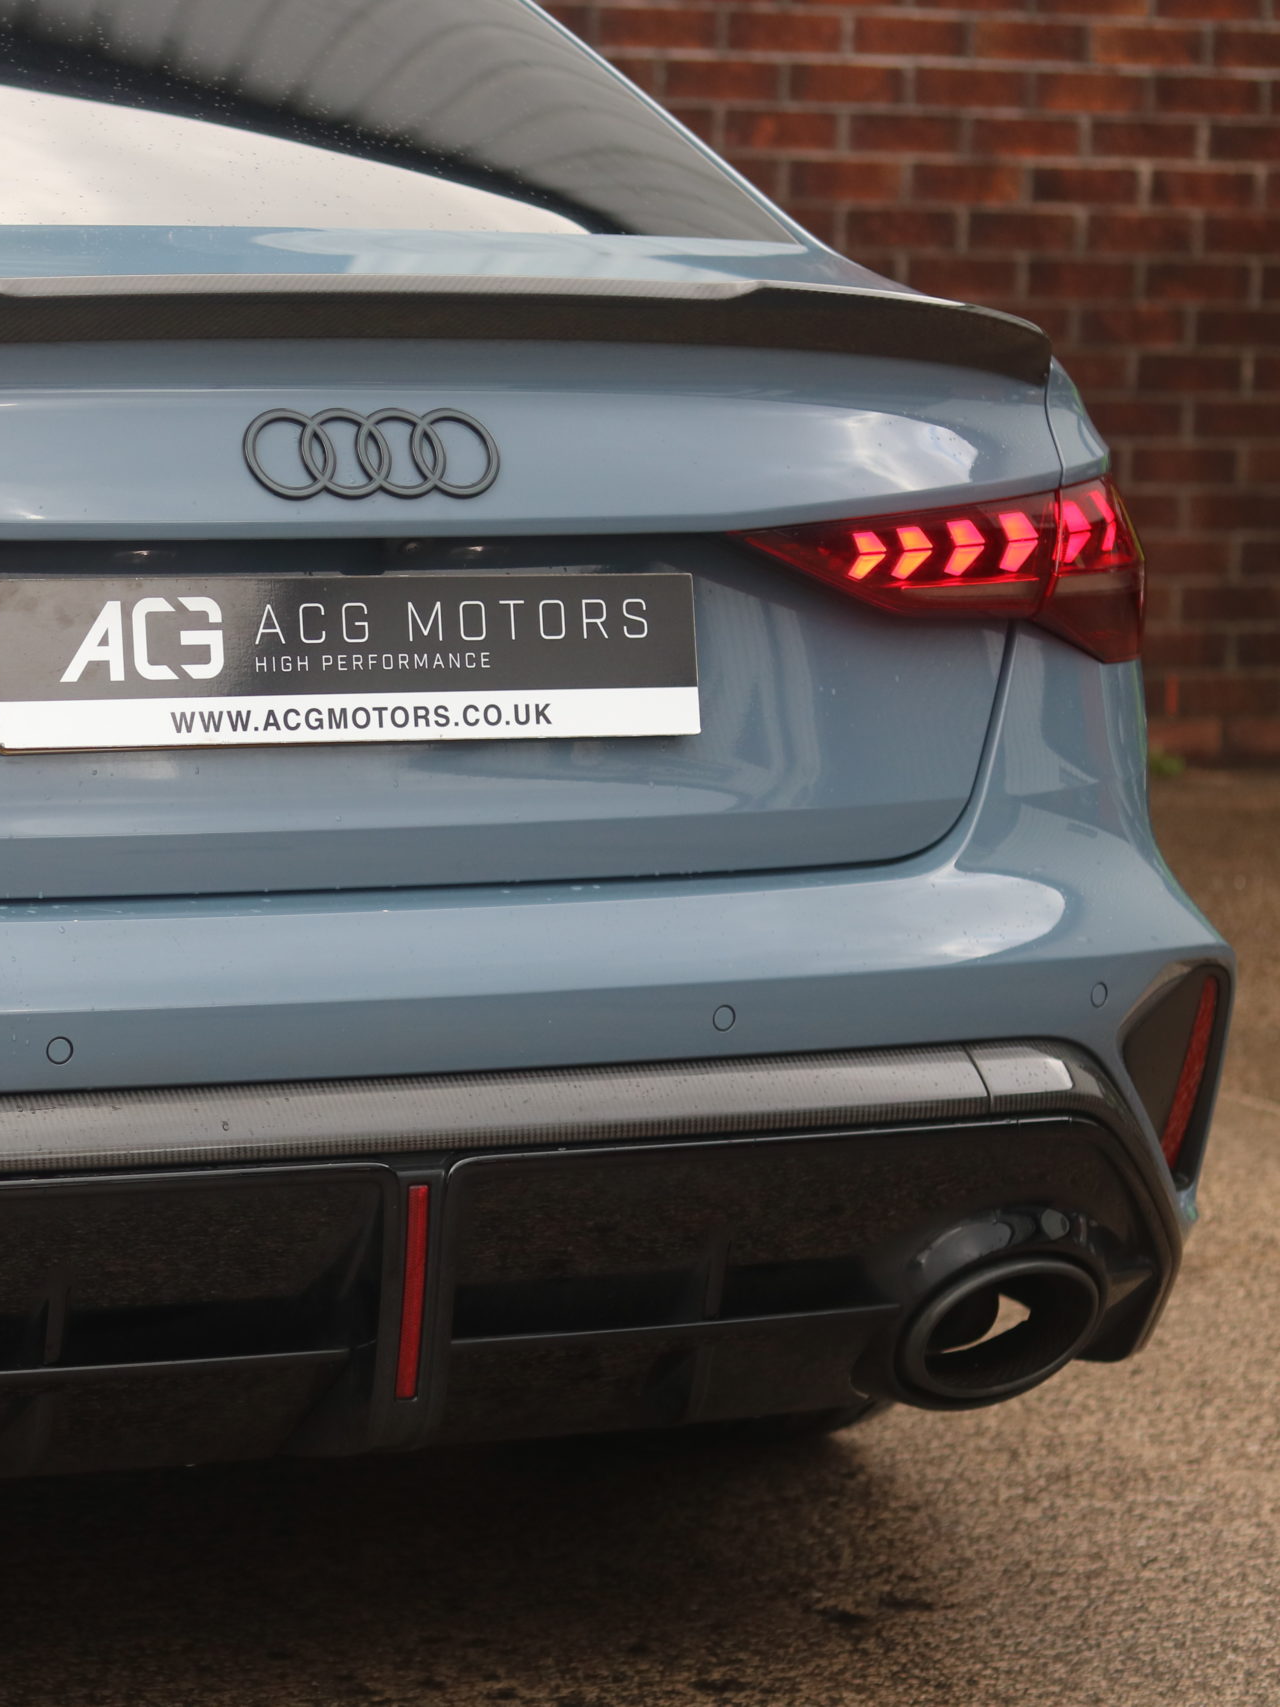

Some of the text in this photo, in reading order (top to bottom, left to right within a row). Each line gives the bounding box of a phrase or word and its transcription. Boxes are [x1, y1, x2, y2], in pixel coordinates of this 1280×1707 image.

[59, 596, 225, 683] ACG
[255, 598, 648, 645] ACG MOTORS
[255, 652, 492, 673] HIGH PERFORMANCE
[170, 703, 553, 734] WWW.ACGMOTORS.CO.UK
